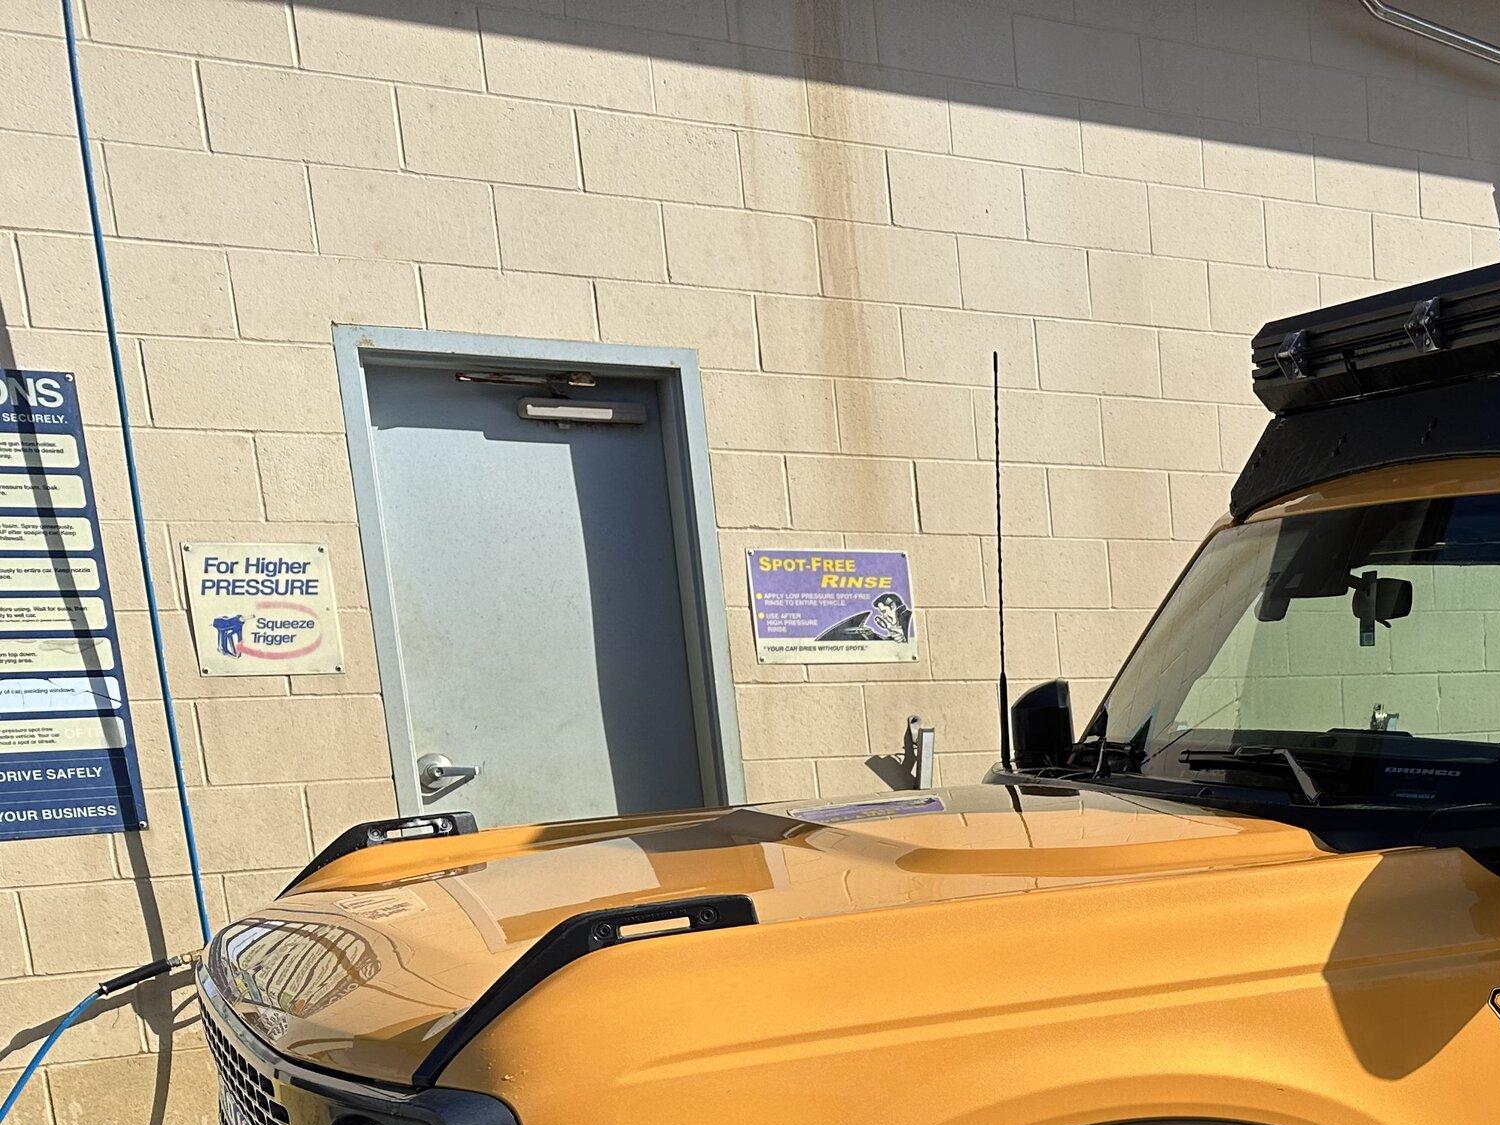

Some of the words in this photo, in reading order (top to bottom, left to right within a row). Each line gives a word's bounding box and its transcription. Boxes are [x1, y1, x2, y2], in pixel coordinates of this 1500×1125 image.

[0, 378, 64, 408] NS
[2, 412, 68, 424] SECURELY.
[203, 557, 239, 574] For
[244, 557, 311, 578] Higher
[758, 556, 856, 572] SPOT-FREE
[201, 579, 319, 596] PRESSURE
[820, 574, 893, 589] RINSE
[256, 618, 315, 631] Squeeze
[251, 632, 297, 646] Trigger
[46, 766, 103, 780] SAFELY
[1384, 766, 1462, 777] BRONCO
[42, 805, 118, 820] BUSINESS
